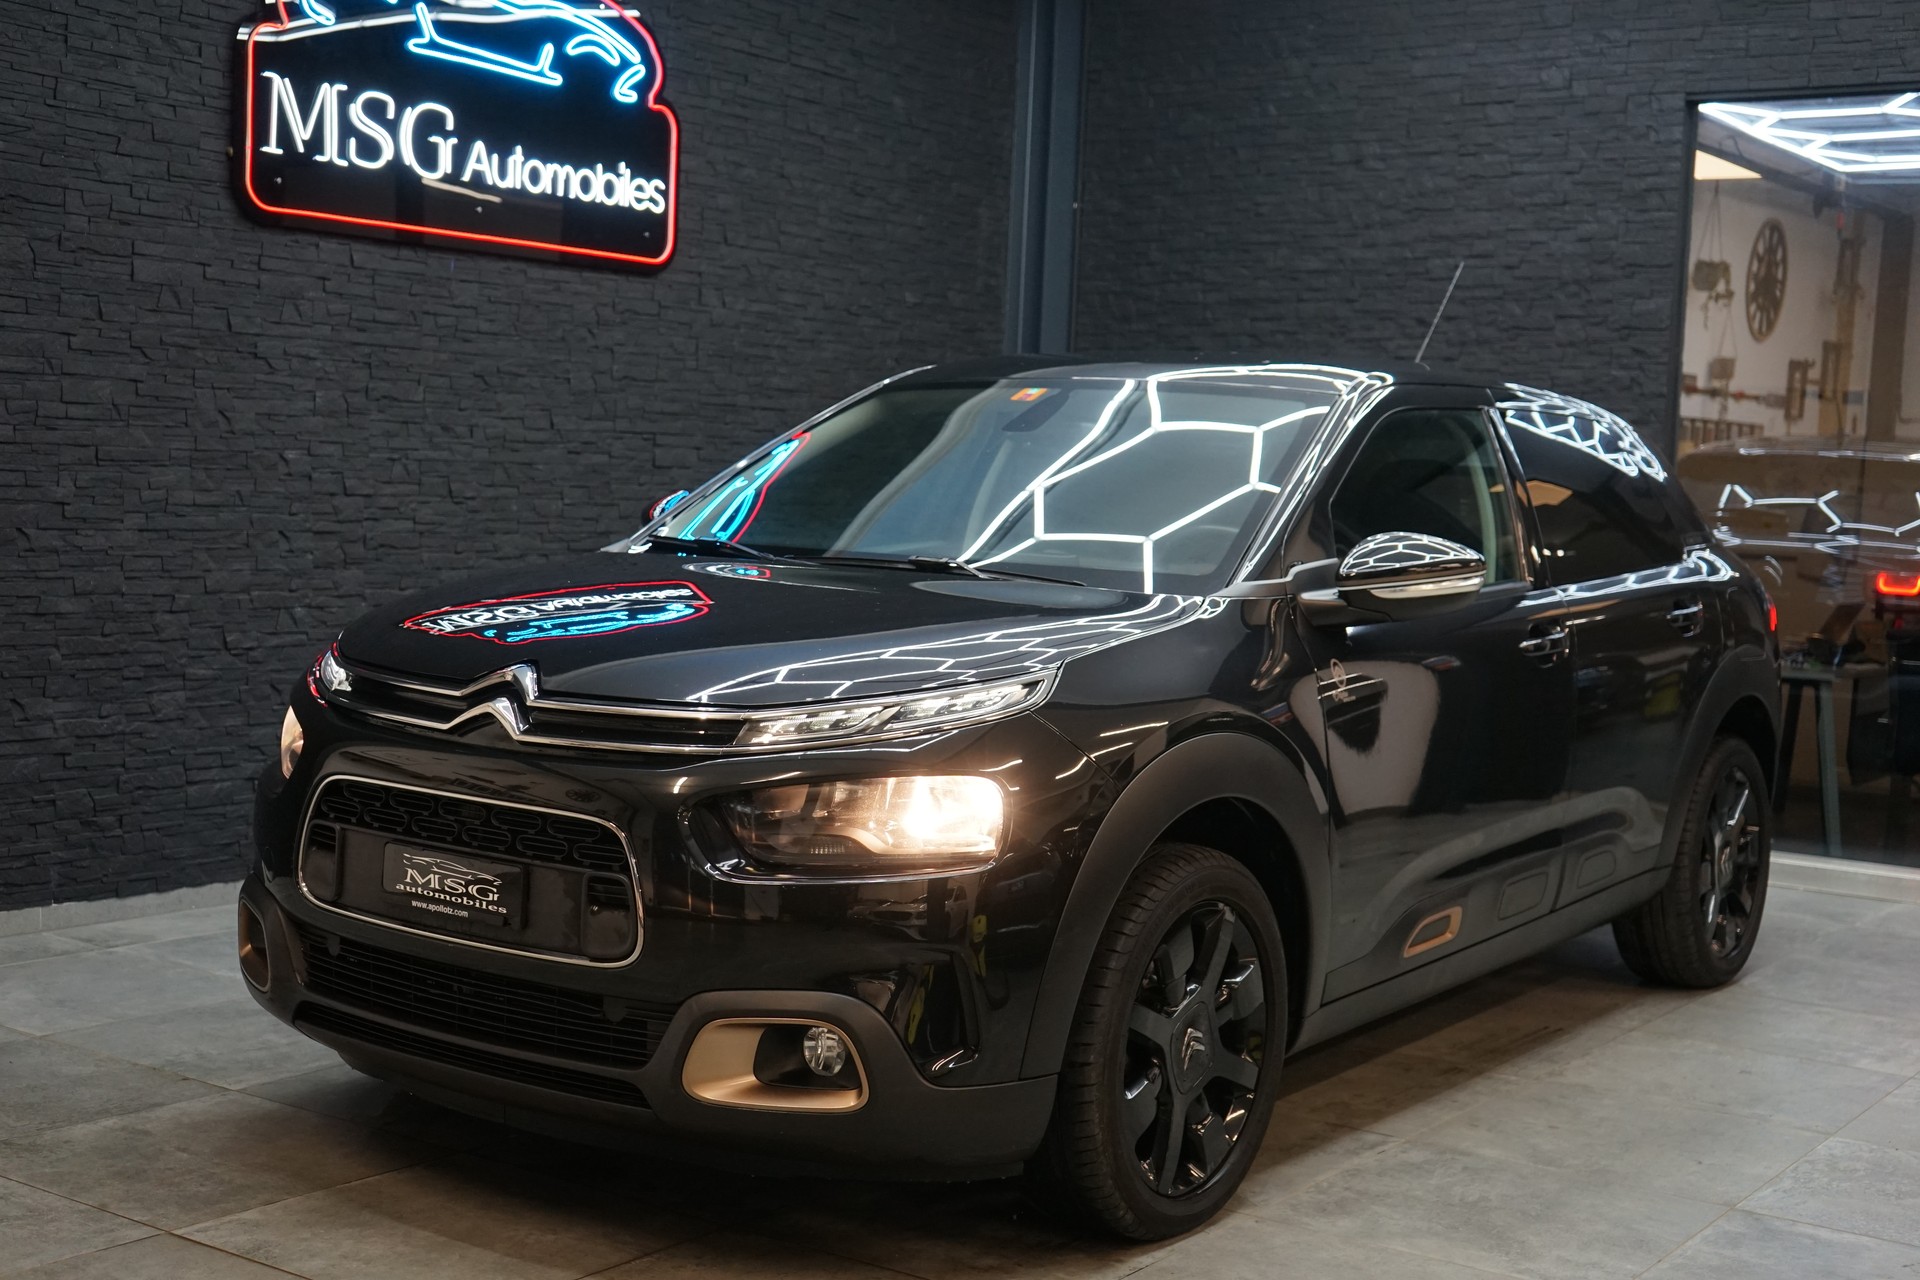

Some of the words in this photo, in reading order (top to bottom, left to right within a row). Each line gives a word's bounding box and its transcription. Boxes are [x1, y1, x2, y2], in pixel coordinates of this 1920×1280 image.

[260, 71, 458, 180] MSG
[460, 140, 667, 215] Automobiles
[395, 883, 508, 914] automobiles
[404, 867, 500, 901] MSG
